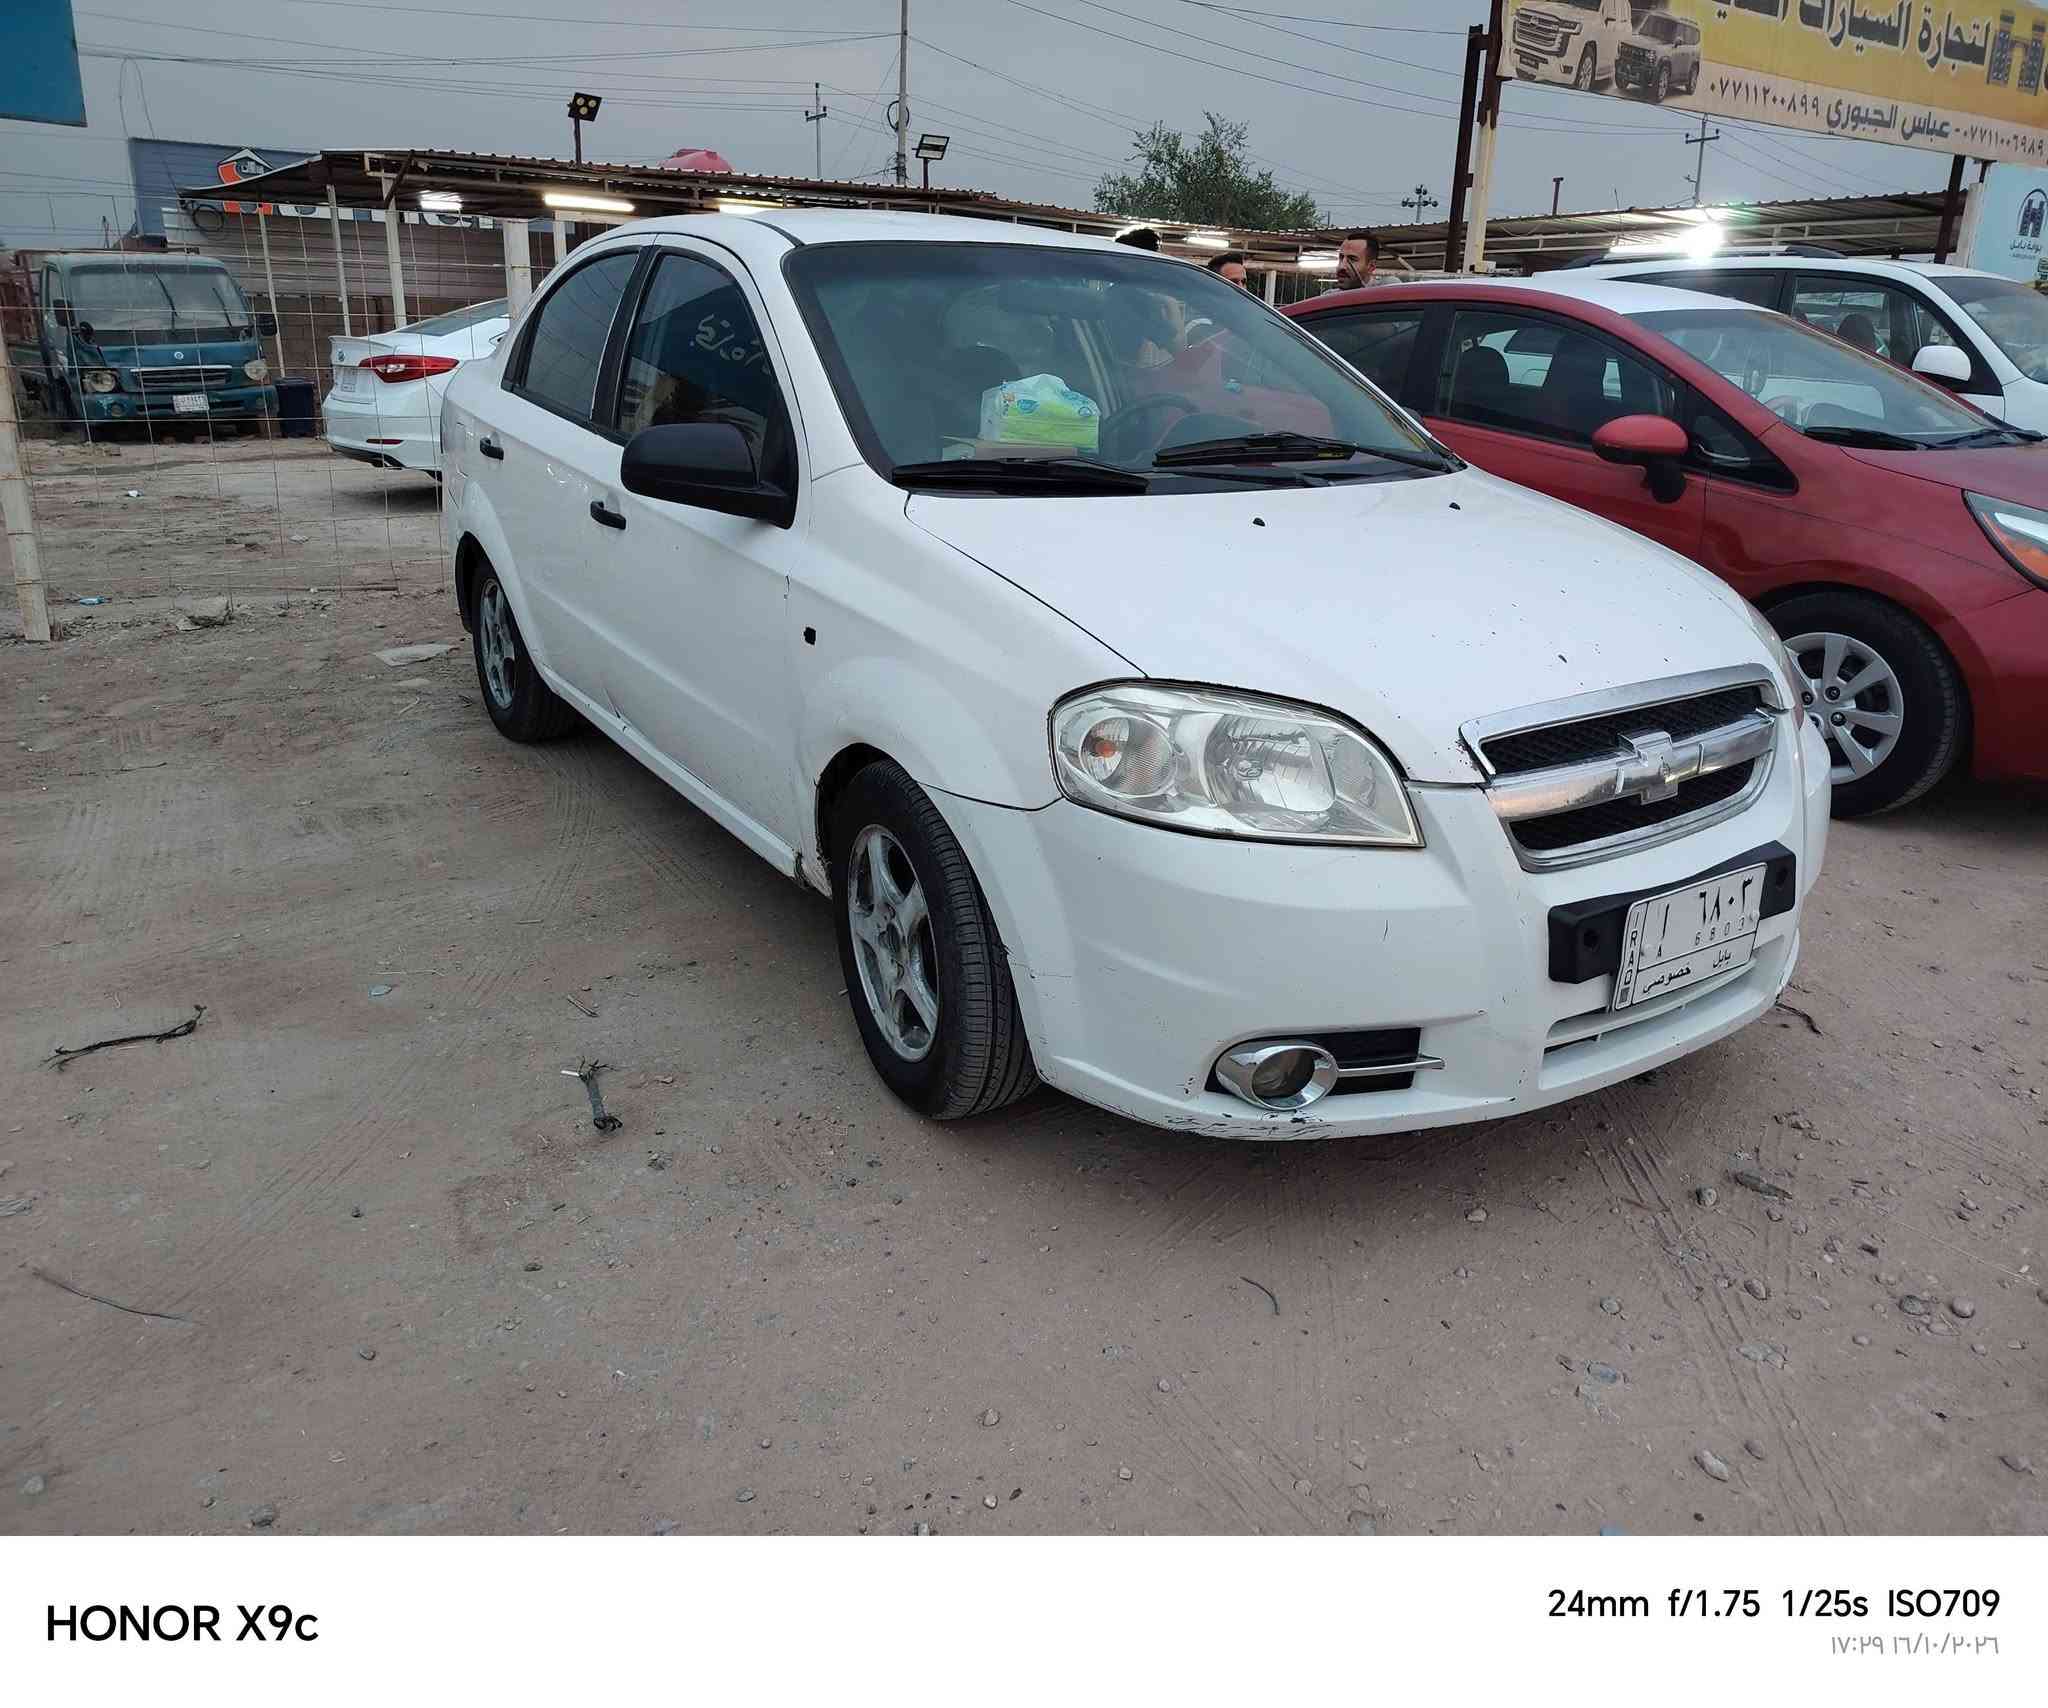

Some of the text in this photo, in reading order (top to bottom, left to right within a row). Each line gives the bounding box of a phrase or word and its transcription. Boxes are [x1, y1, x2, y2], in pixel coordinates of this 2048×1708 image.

[1917, 4, 1991, 72] لتجارة
[1709, 75, 1820, 118] ٠٧٧١١٢٠٠٨٩٩
[1826, 99, 1899, 135] الجبوري
[1901, 111, 1950, 143] عباس
[1699, 875, 1753, 924] ٦٨٠٣
[1623, 911, 1641, 985] IRAQ
[1644, 948, 1732, 993] بابل خصوصي
